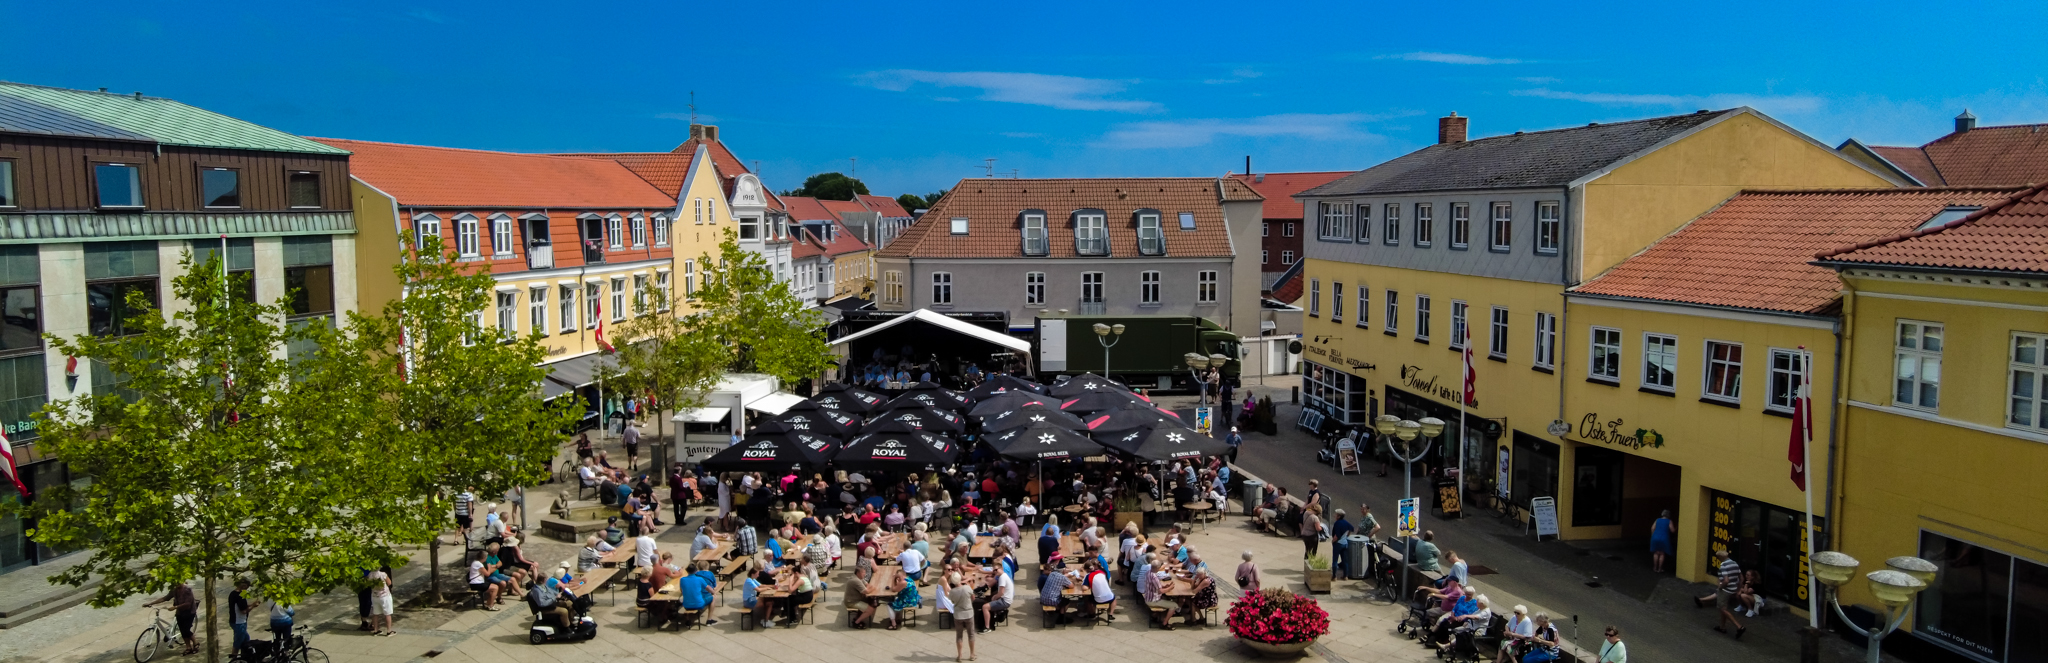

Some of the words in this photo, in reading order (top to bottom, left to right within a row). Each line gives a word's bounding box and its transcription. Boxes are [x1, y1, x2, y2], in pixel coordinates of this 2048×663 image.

[684, 445, 723, 457] Lantern
[1927, 625, 1951, 638] RESPEKT
[1952, 634, 1964, 643] FOR
[1965, 639, 1976, 647] DIT
